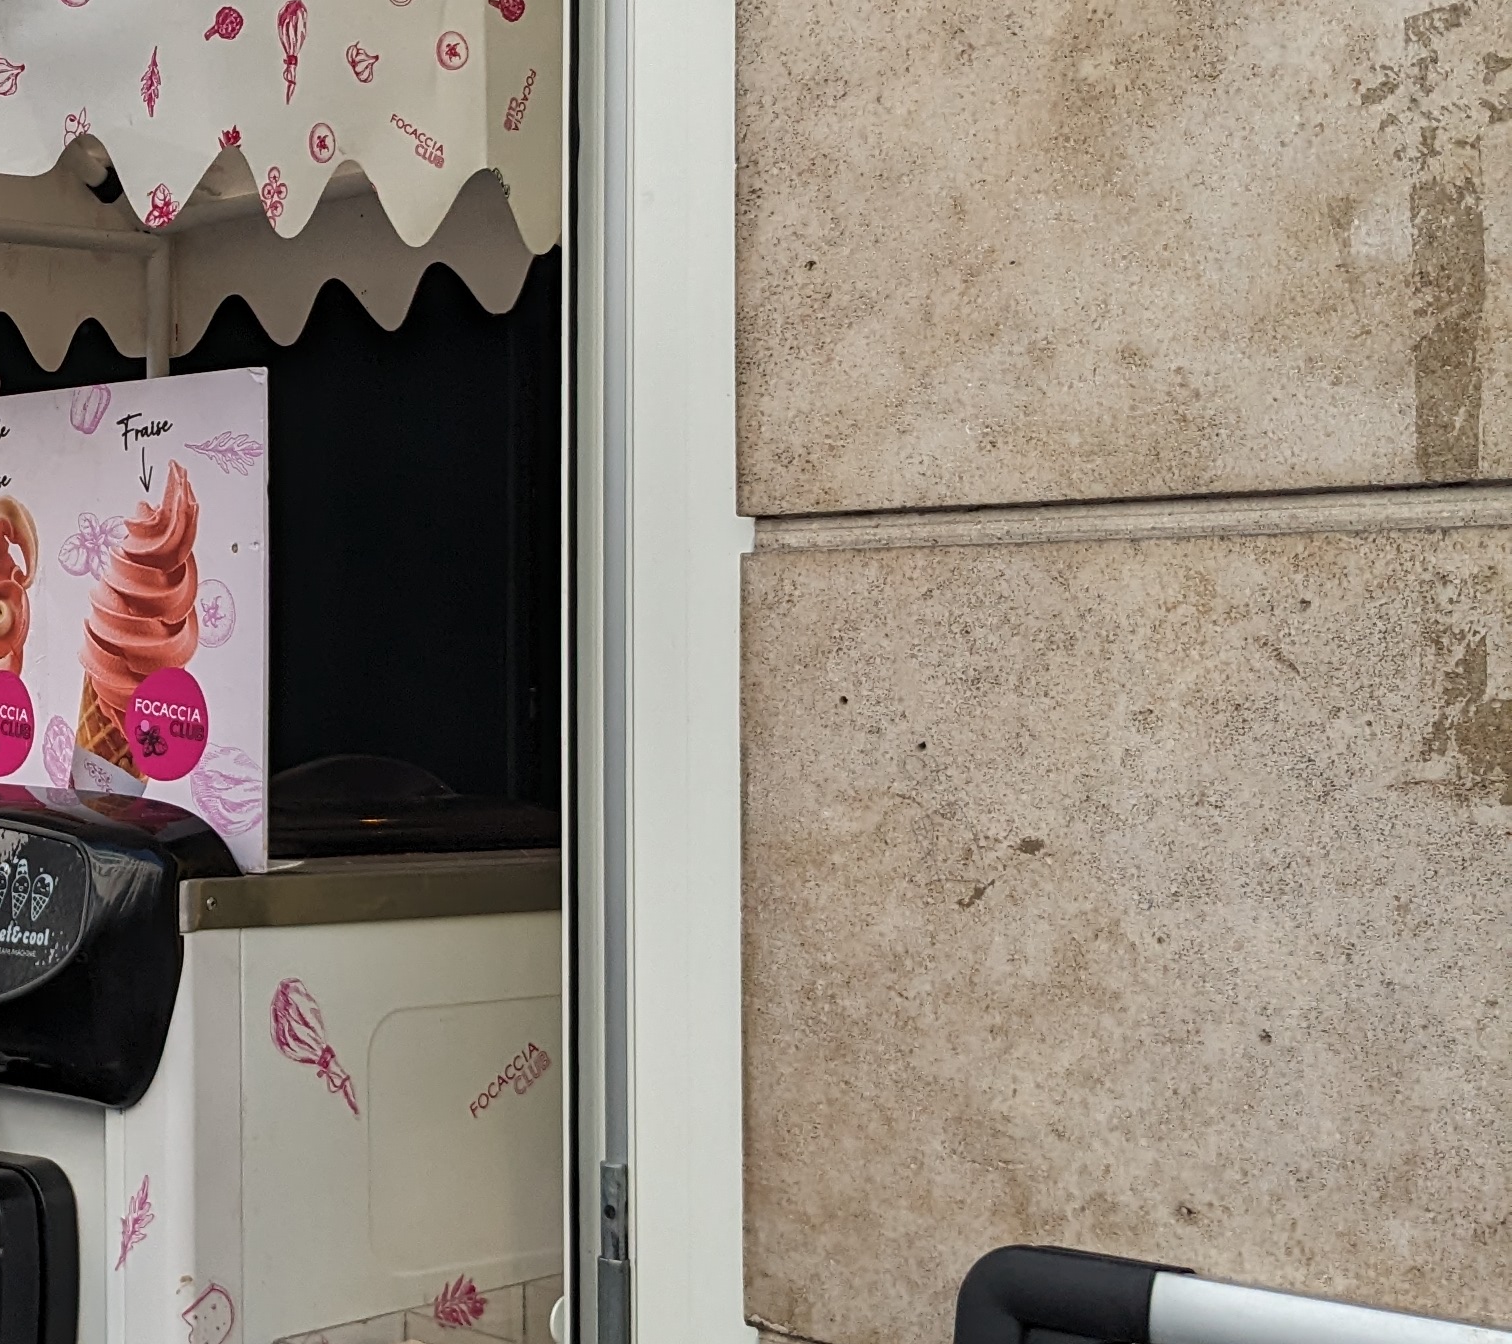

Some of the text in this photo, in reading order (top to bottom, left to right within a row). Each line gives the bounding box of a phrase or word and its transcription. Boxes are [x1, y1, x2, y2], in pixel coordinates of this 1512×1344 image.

[511, 68, 537, 132] FOCACCIA
[390, 114, 444, 156] FOCACCIA
[415, 144, 445, 169] CLUB
[116, 413, 174, 450] Fraise
[134, 698, 201, 723] FOCACCIA
[0, 720, 32, 740] CLUB
[169, 720, 205, 742] CLUB
[469, 1042, 539, 1118] FOCACCIA
[514, 1051, 551, 1094] CLUB
